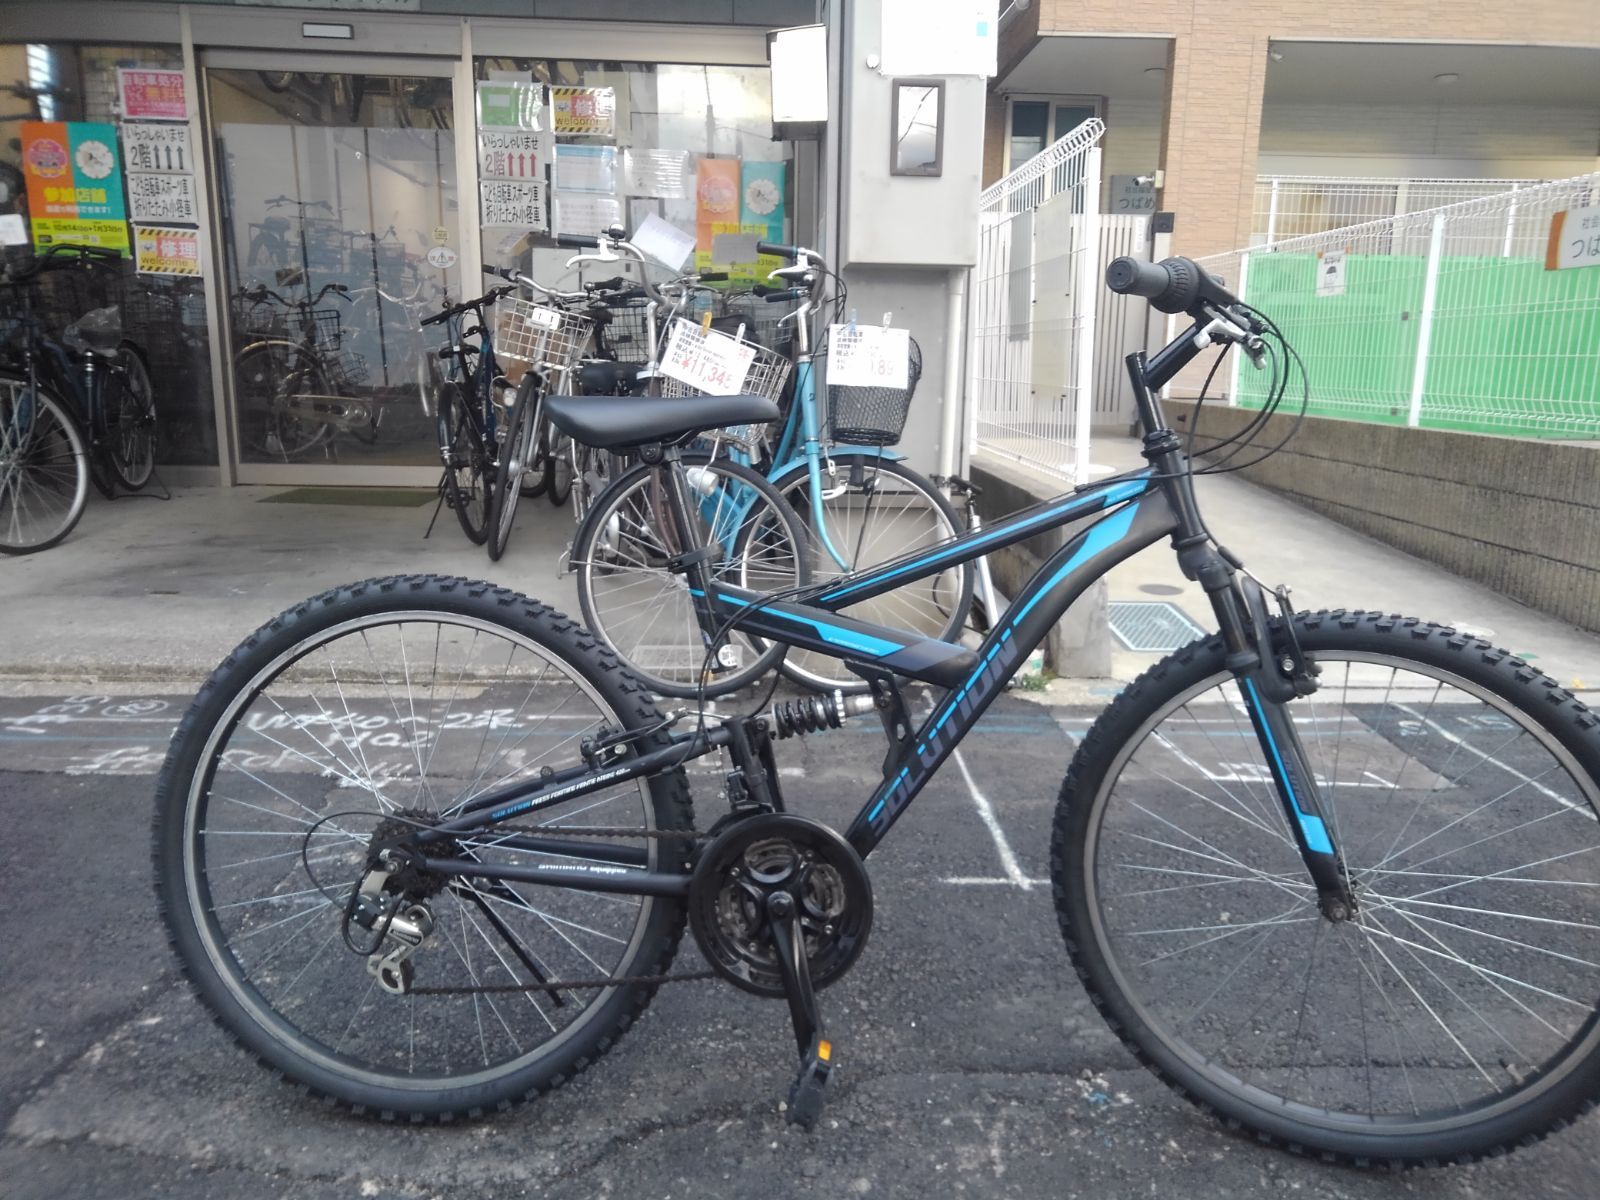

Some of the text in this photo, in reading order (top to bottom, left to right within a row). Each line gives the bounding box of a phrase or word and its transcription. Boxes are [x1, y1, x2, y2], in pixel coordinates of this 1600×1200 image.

[126, 125, 185, 142] いらっしゃいませ
[483, 134, 538, 150] いらっしゃいませ
[131, 143, 152, 168] 2階
[485, 151, 505, 176] 2階
[160, 239, 198, 259] 修理
[141, 256, 188, 267] welcome
[867, 627, 1018, 837] SOLUTION
